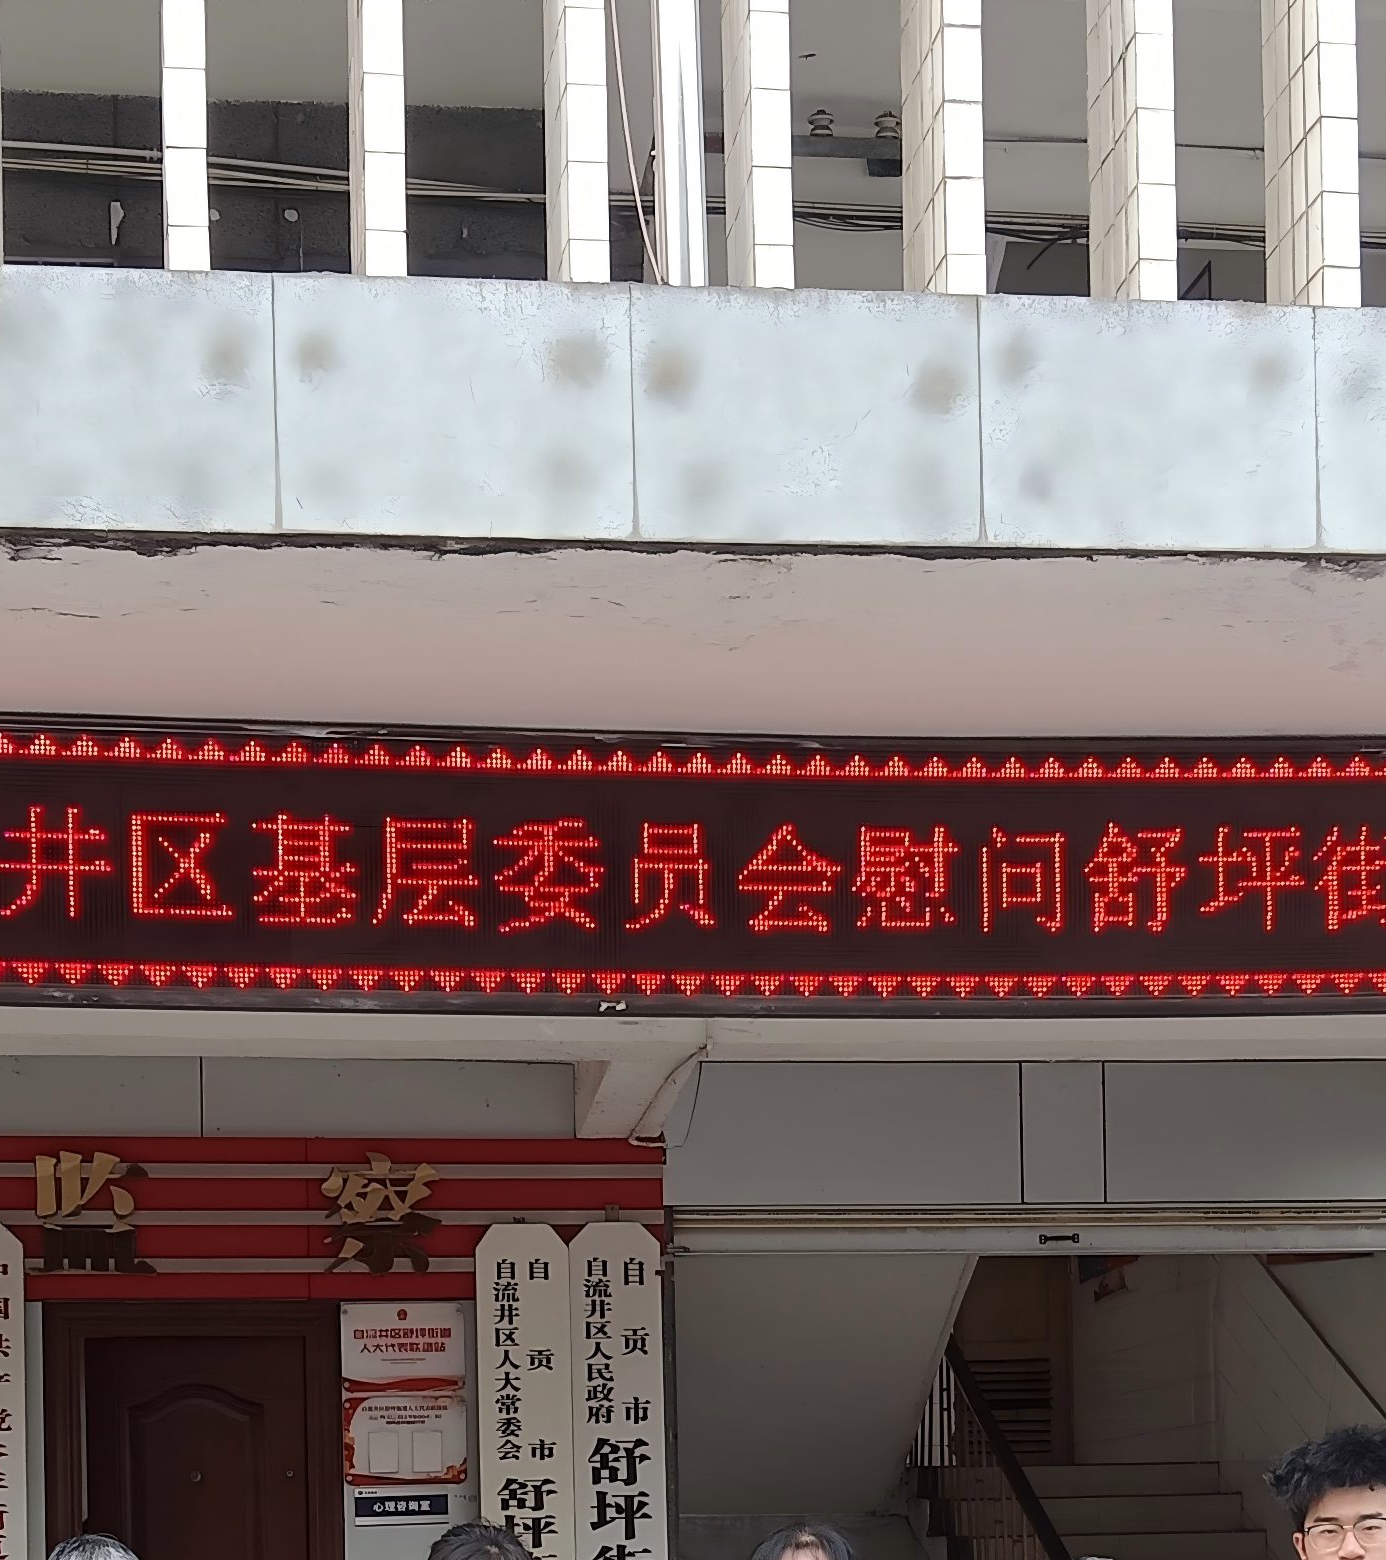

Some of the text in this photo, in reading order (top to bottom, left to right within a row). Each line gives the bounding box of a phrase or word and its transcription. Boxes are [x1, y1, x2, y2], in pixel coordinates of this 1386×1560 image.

[493, 1258, 522, 1461] 自流井区人大常委会
[526, 1258, 557, 1461] 自贡市
[583, 1257, 614, 1424] 自流井区人民政府
[621, 1257, 651, 1425] 自贡市
